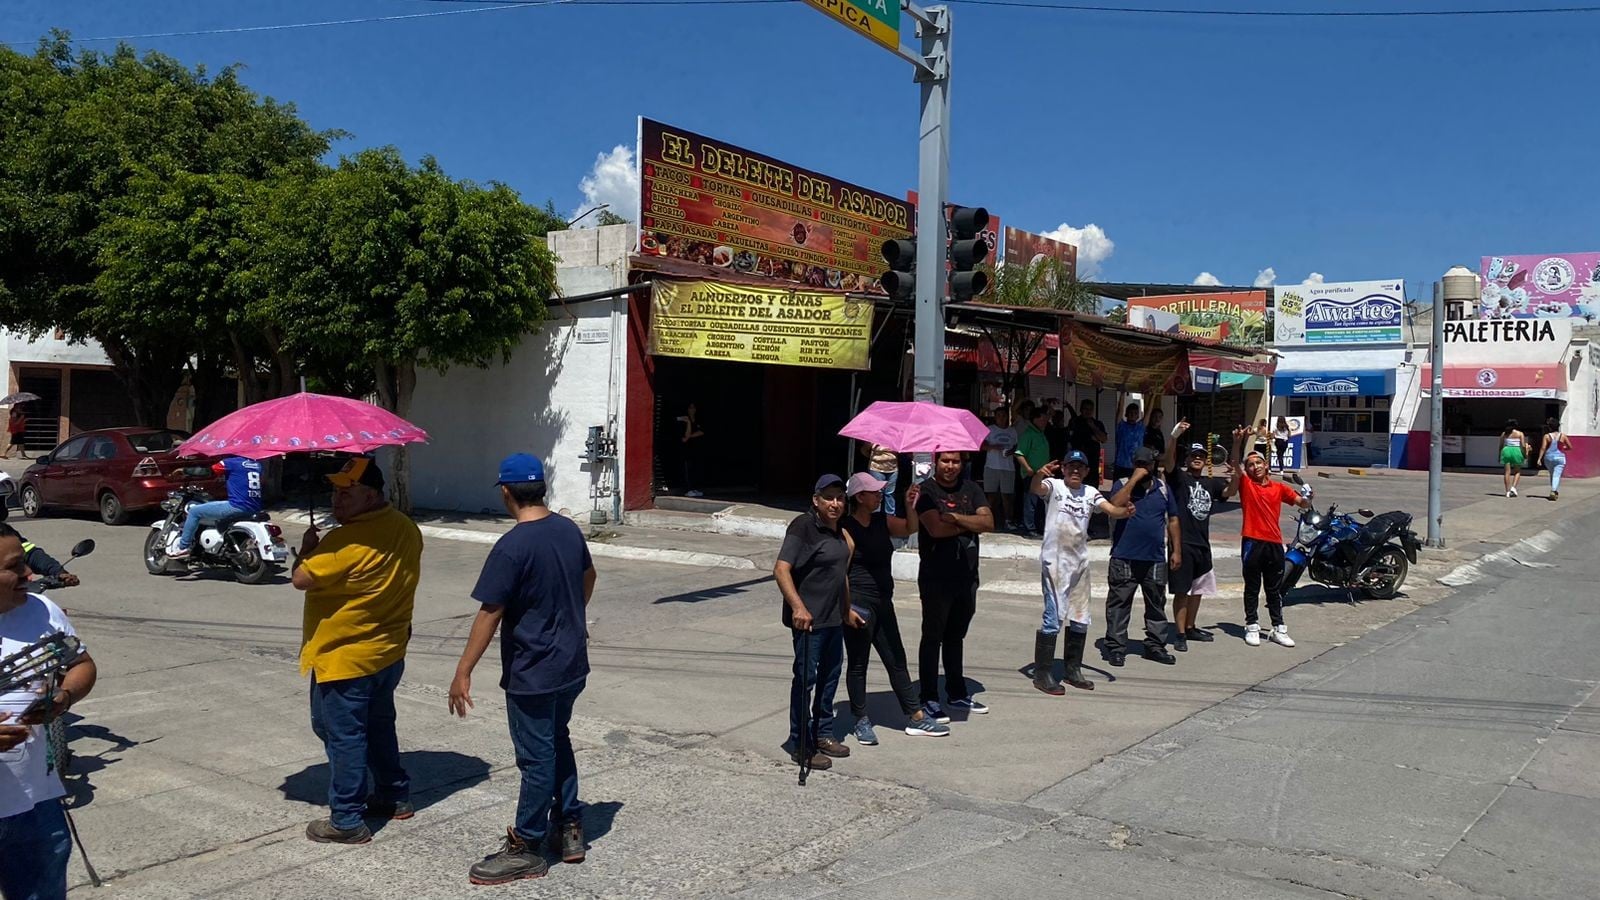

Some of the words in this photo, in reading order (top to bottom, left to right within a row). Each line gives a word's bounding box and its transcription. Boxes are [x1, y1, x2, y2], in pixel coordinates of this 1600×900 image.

[661, 131, 695, 168] EL
[701, 143, 793, 196] DELEITE
[798, 173, 834, 208] DEL
[839, 187, 908, 229] ASADOR
[653, 182, 699, 200] ARRACHERA
[653, 193, 678, 206] BISTEC
[655, 165, 690, 184] TACOS
[703, 179, 742, 198] TORTAS
[752, 192, 812, 217] QUESADILLAS
[820, 211, 871, 233] QUESITORTAS
[713, 198, 743, 212] CHORIZO
[652, 204, 685, 219] CHORIZO
[722, 211, 760, 226] ARGENTINO
[713, 219, 740, 232] CABEZA
[655, 220, 683, 233] PAPAS
[684, 226, 717, 240] ASADAS
[725, 235, 769, 251] CAZUELITAS
[777, 246, 799, 258] QUESO
[800, 250, 829, 263] FUNDIDO
[1283, 291, 1304, 303] Hasta
[1325, 286, 1354, 295] purificada
[690, 291, 762, 306] ALMUERZOS
[767, 295, 776, 306] Y
[779, 295, 823, 307] CENAS
[680, 304, 694, 314] EL
[697, 304, 746, 317] DELEITE
[749, 306, 773, 318] DEL
[776, 308, 831, 321] ASADOR
[1154, 299, 1241, 317] ORTILLERIA
[681, 319, 706, 328] TORTAS
[709, 322, 760, 332] QUESADILLAS
[762, 324, 815, 335] QUESITORTAS
[819, 328, 863, 337] VOLCANES
[1443, 320, 1556, 343] PALETERIA
[707, 333, 736, 342] CHORIZO
[753, 336, 787, 345] COSTILLA
[801, 339, 830, 347] PASTOR
[706, 341, 745, 350] ARGENTINO
[705, 349, 731, 358] CABEZA
[752, 352, 780, 361] LENGUA
[799, 356, 834, 365] SUADERO
[1449, 389, 1462, 397] La
[1463, 389, 1526, 397] Michoacana
[247, 471, 261, 489] 8
